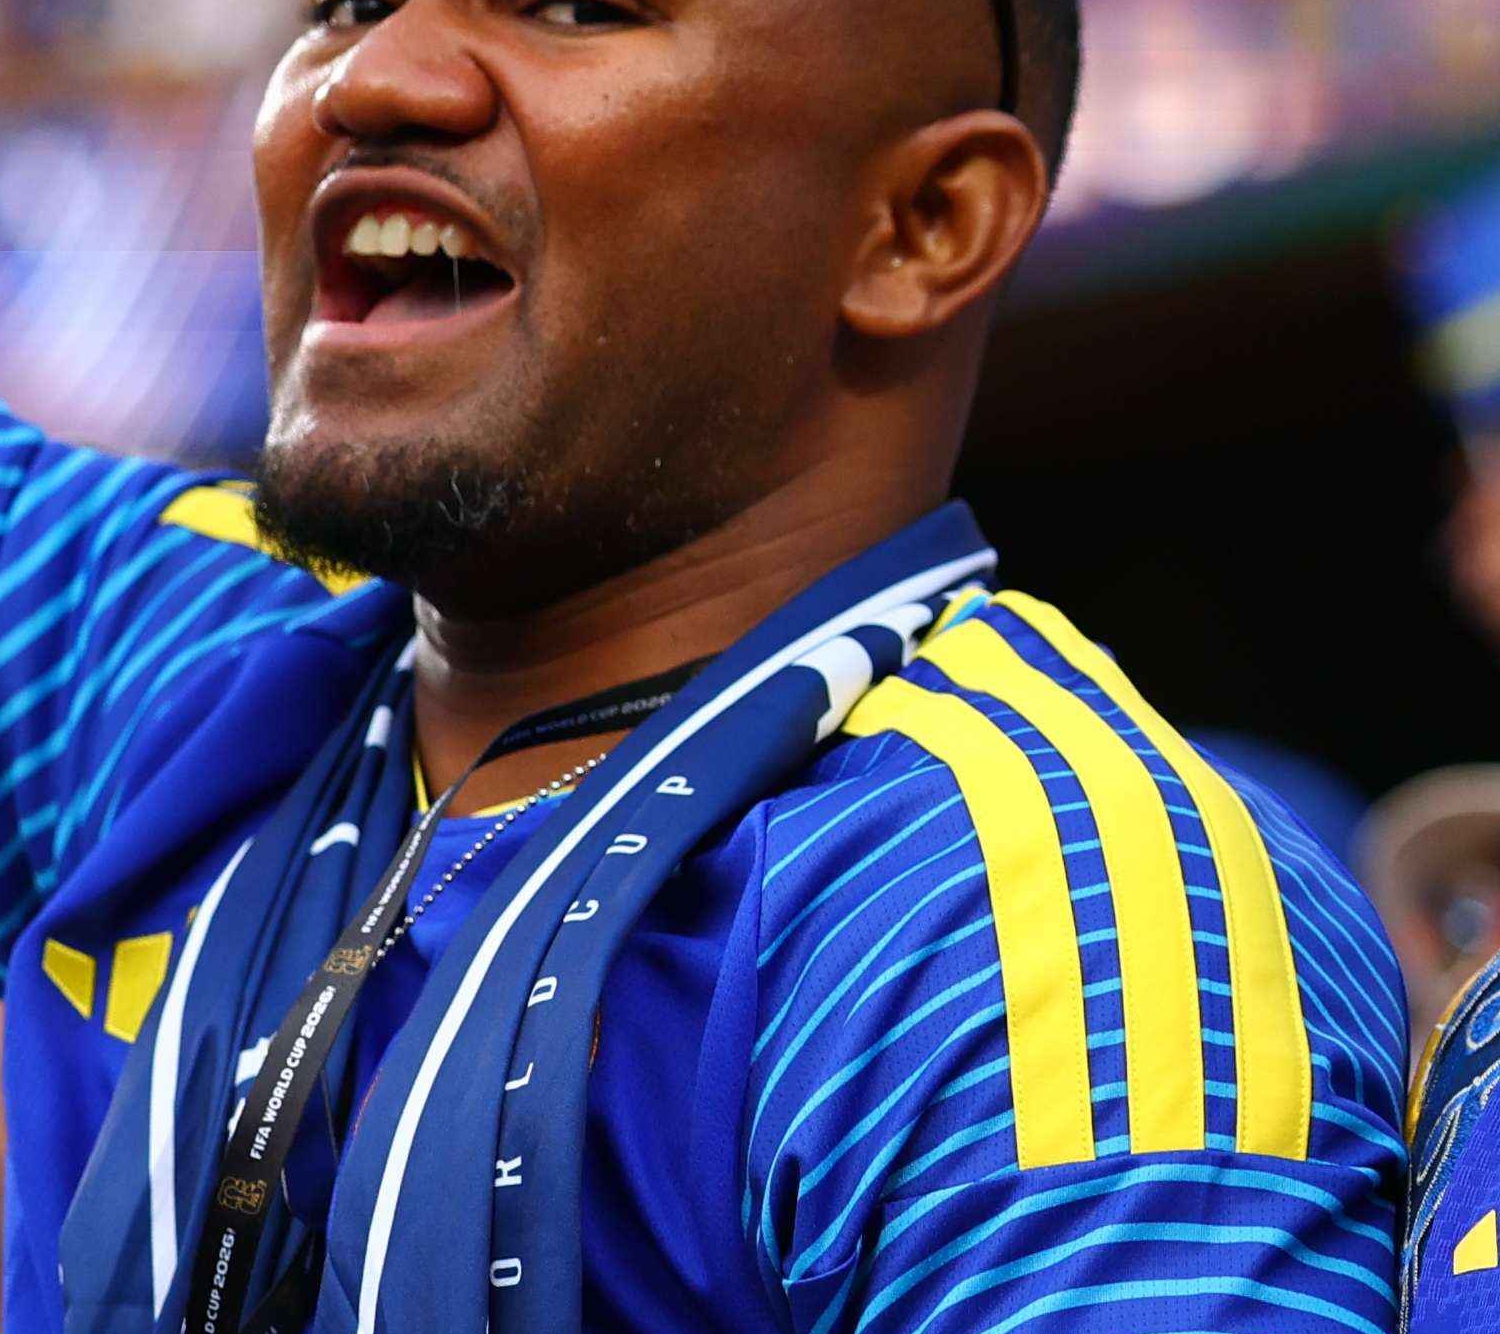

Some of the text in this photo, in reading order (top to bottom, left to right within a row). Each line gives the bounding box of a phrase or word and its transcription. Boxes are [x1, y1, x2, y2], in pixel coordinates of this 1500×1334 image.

[563, 774, 696, 923] CUP
[250, 986, 336, 1161] FIFA WORLD CUP 2026
[209, 1288, 222, 1322] CUP
[213, 1229, 237, 1289] 2026
